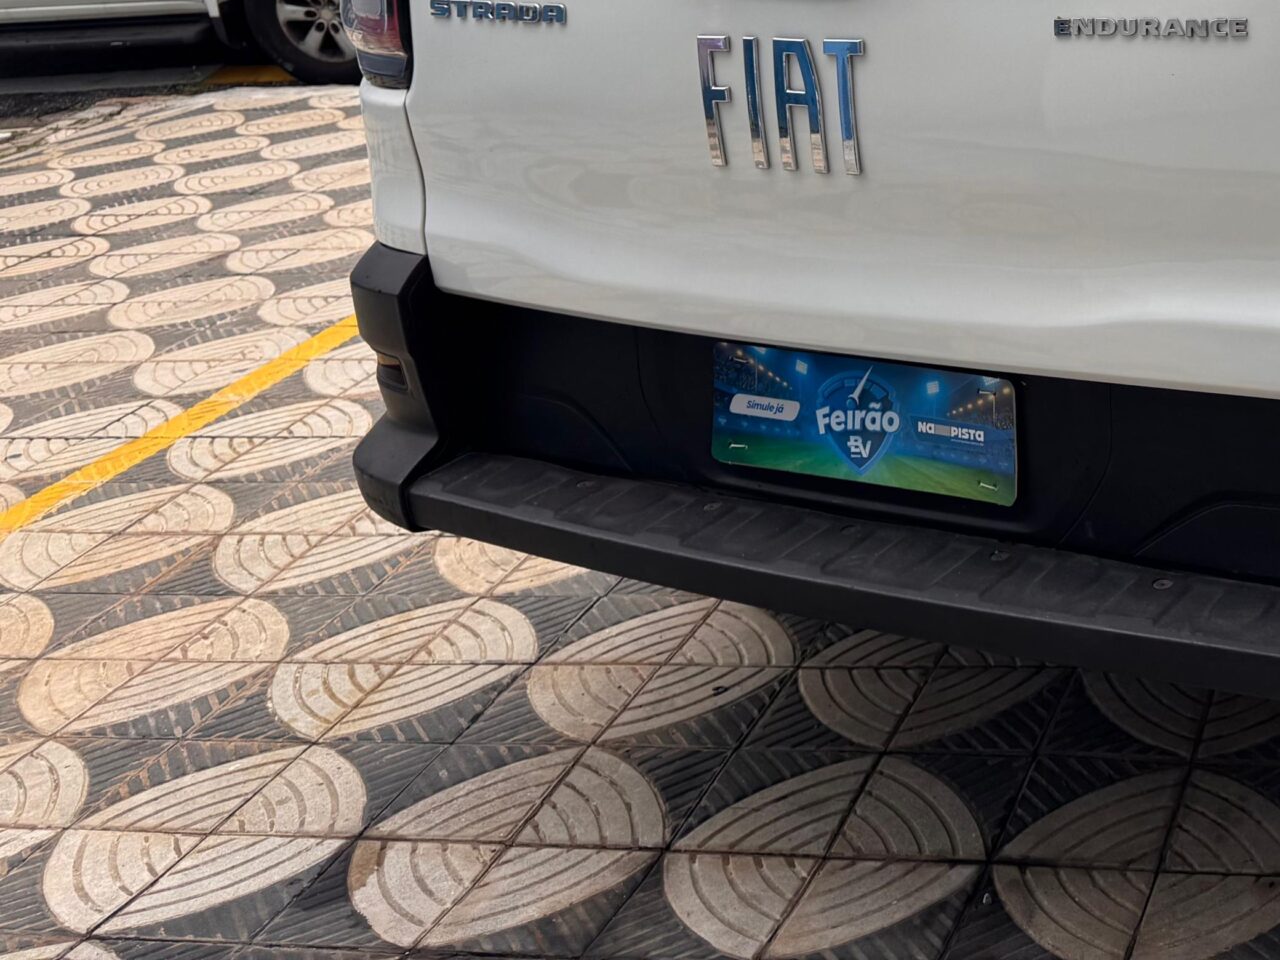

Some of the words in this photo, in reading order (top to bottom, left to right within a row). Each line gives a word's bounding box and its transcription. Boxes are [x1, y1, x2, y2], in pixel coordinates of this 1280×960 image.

[1053, 17, 1249, 39] ENDURANCE
[696, 35, 866, 176] FIAT
[746, 400, 775, 412] Simule
[774, 403, 785, 414] já
[815, 401, 900, 435] Feirão
